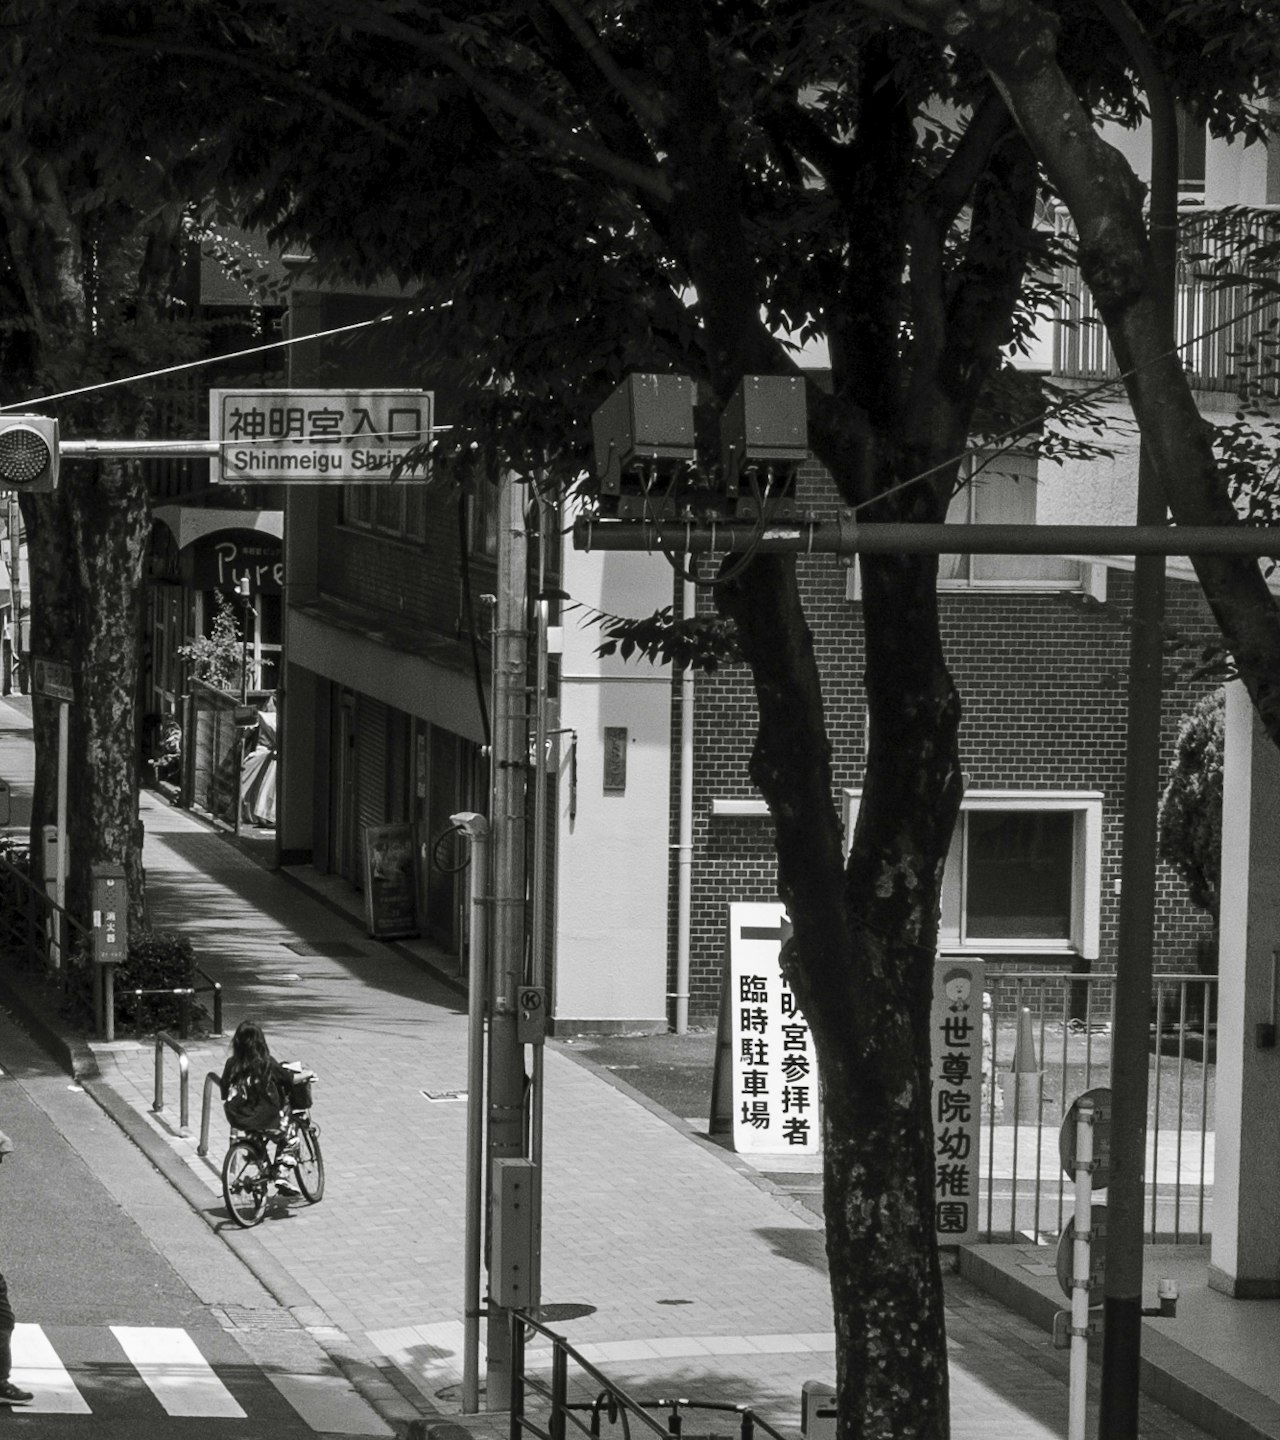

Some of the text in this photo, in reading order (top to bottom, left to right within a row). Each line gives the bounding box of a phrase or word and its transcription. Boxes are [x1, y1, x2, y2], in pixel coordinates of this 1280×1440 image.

[228, 406, 421, 444] 神明宮入口
[234, 450, 342, 473] Shinmeigu
[214, 542, 284, 587] Pure
[739, 974, 770, 1130] 臨時駐車場
[778, 971, 811, 1146] 明宮参拝者
[934, 1016, 974, 1234] 世尊院幼稚園
